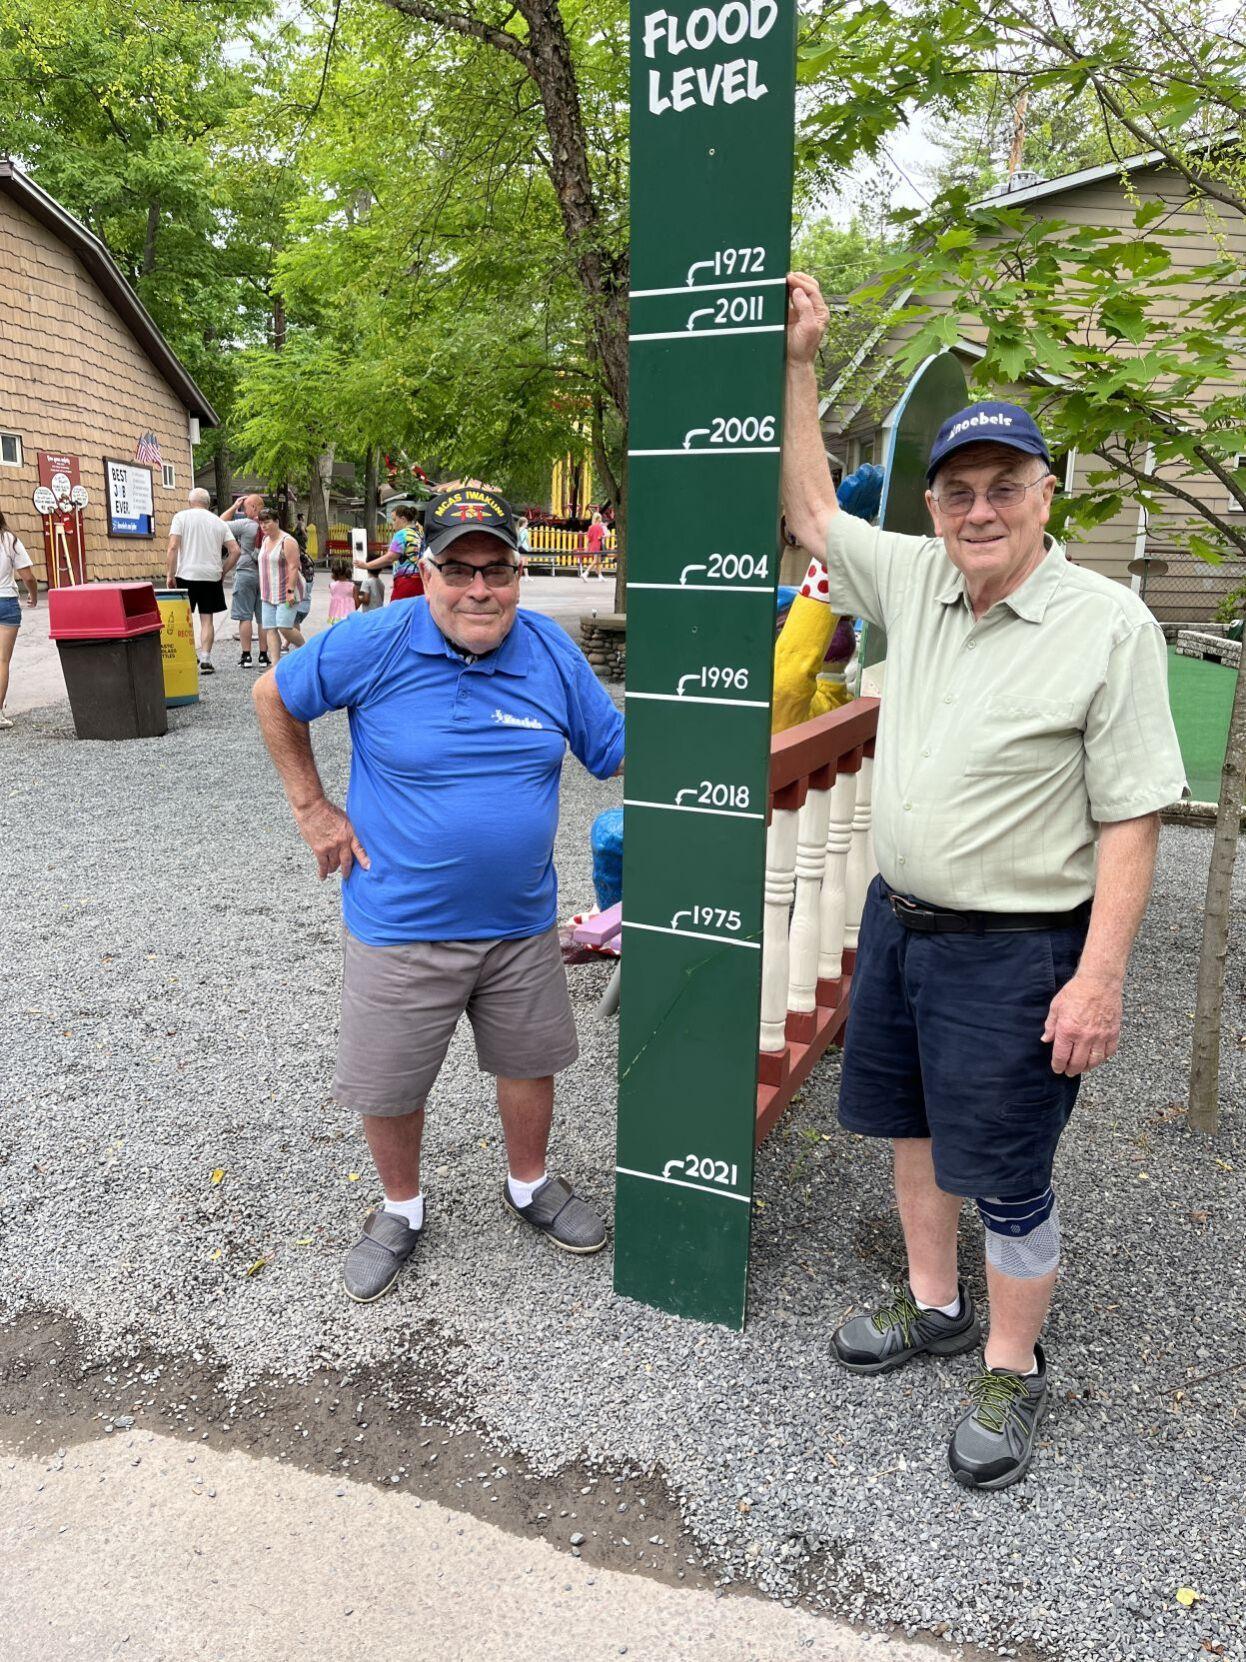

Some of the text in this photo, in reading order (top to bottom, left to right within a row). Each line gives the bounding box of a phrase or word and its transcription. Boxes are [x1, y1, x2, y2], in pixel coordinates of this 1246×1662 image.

[642, 0, 778, 58] FLOOD
[649, 59, 768, 115] LEVEL
[714, 246, 766, 276] 1972
[714, 296, 764, 324] 2011
[710, 416, 775, 443] 2006
[112, 467, 128, 483] BEST
[434, 491, 505, 517] MCAS IWAKUNI
[707, 553, 769, 580] 2004
[701, 666, 750, 690] 1996
[698, 780, 750, 808] 2018
[694, 905, 742, 931] 1975
[686, 1154, 738, 1186] 2021
